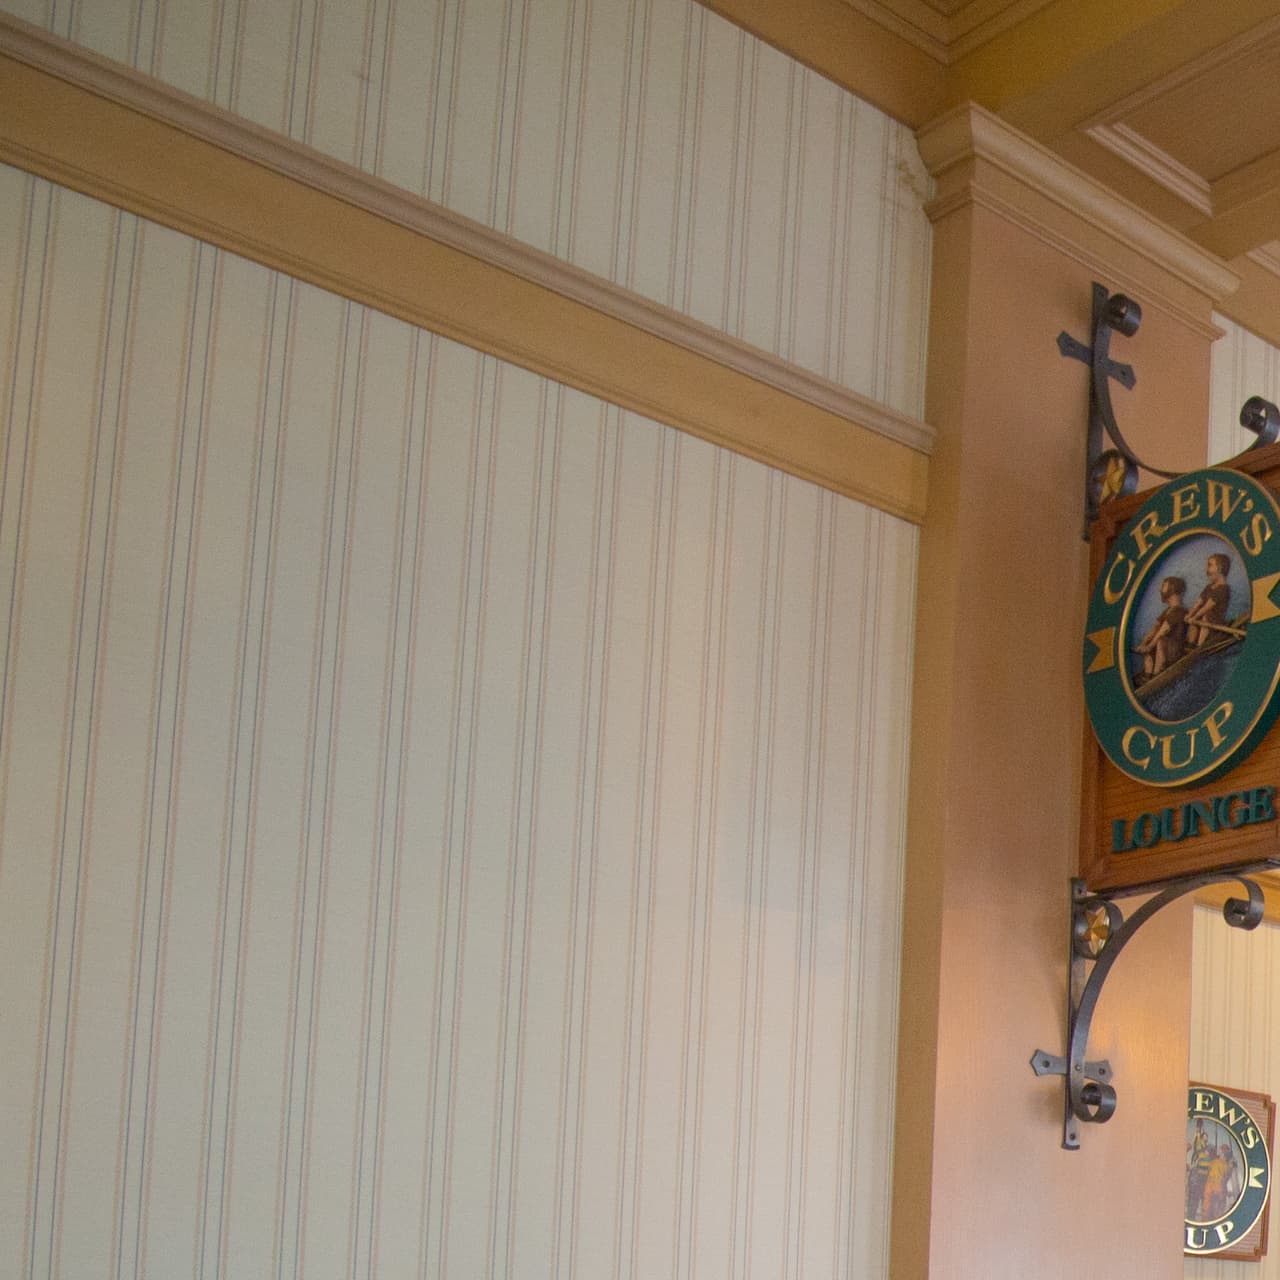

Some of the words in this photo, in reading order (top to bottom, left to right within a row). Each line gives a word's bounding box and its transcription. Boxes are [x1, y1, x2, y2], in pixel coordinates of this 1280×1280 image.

[1103, 479, 1273, 606] CREW'S
[1121, 700, 1235, 770] CUP
[1110, 785, 1278, 853] LOUNGE
[1183, 1219, 1236, 1250] UP
